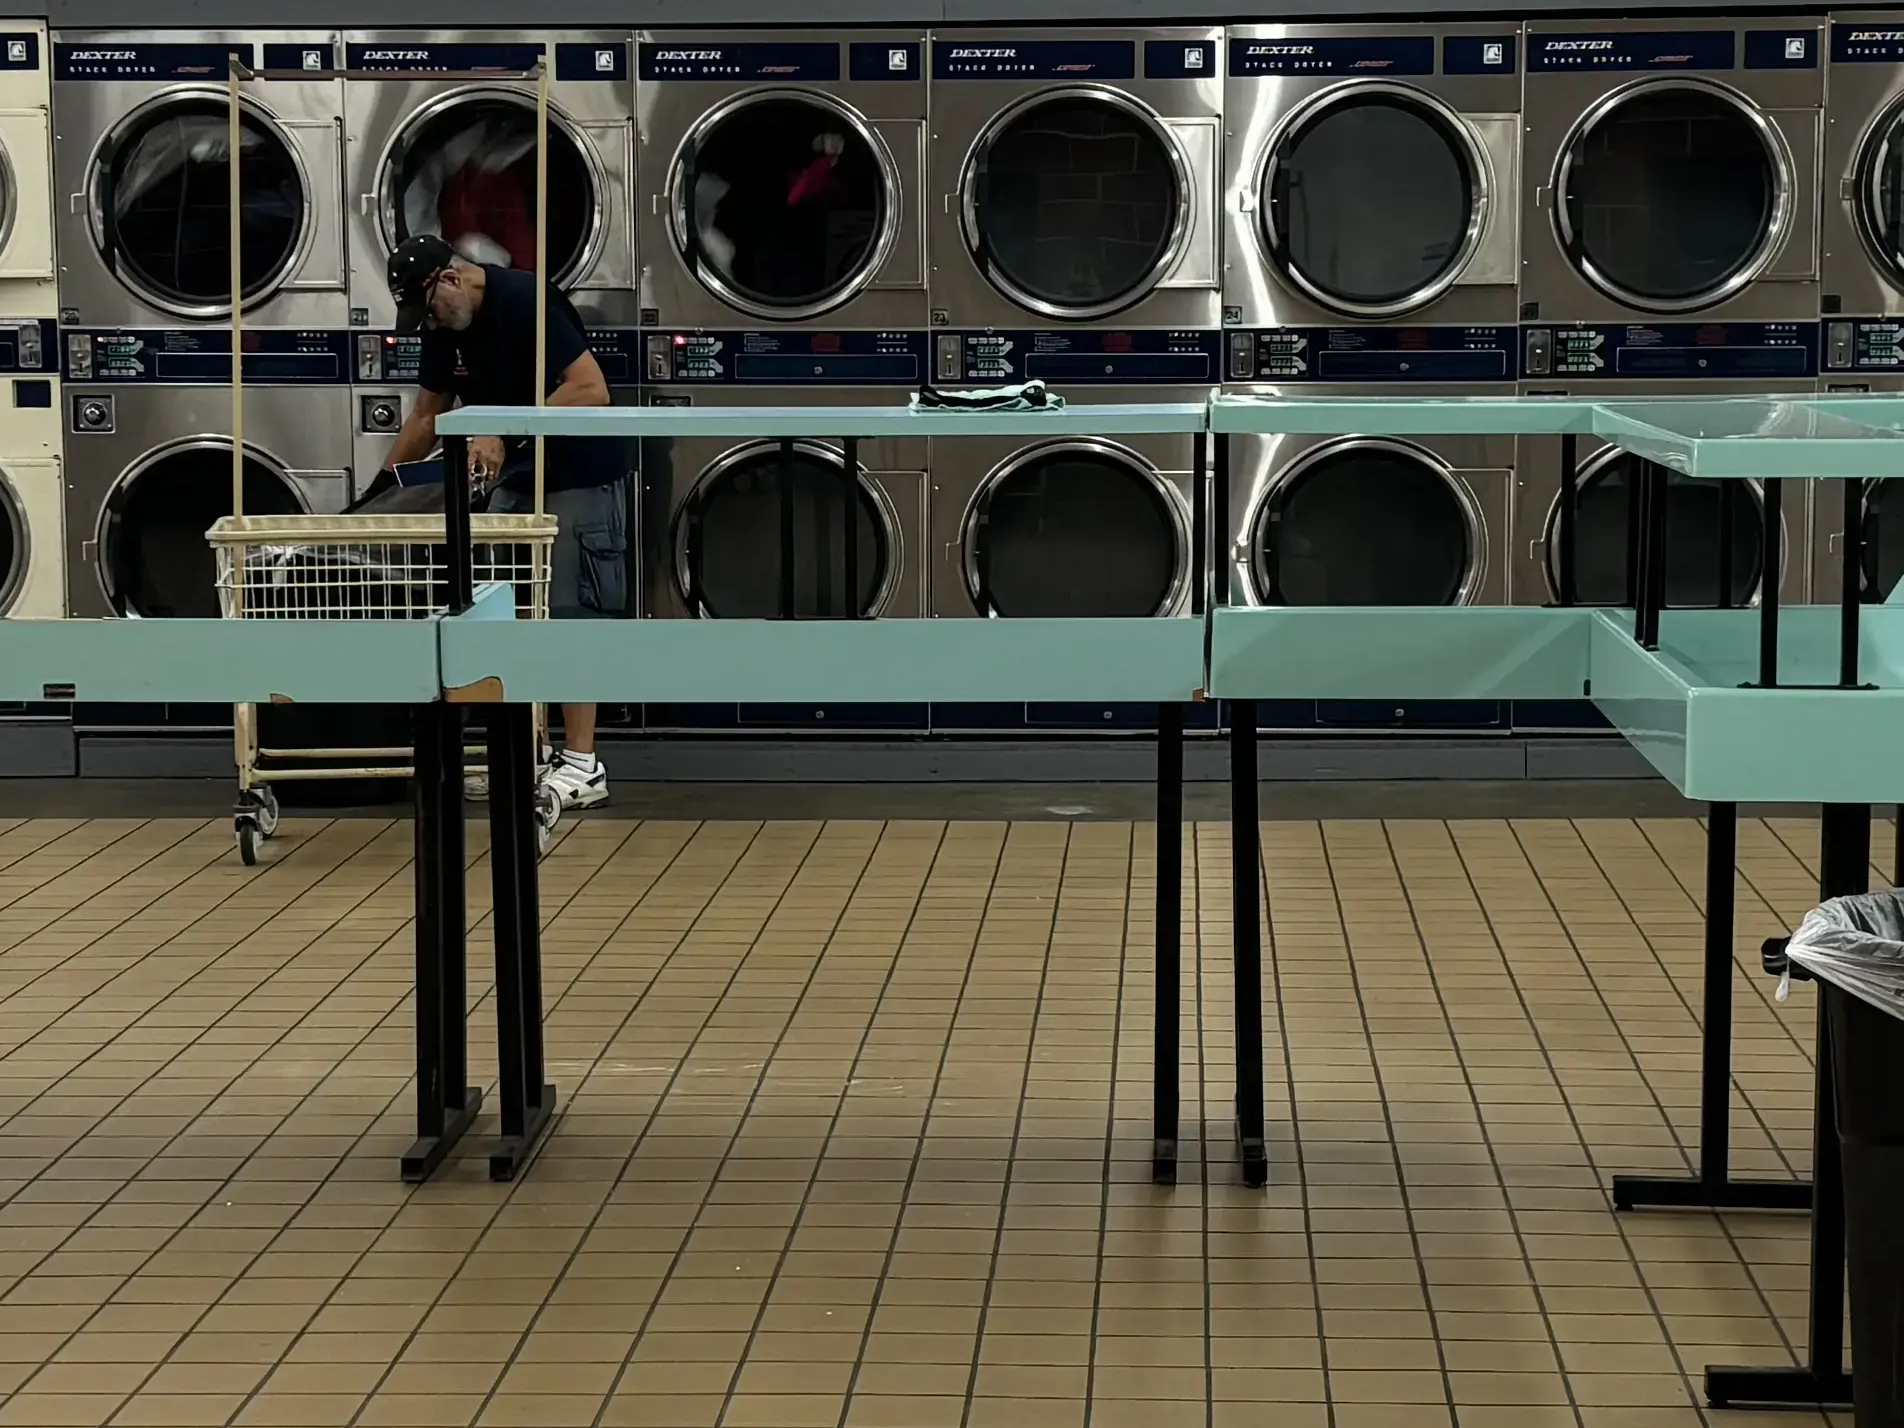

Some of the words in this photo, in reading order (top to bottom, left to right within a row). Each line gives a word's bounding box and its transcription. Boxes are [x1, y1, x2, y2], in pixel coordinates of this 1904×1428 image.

[1246, 45, 1314, 55] DEXTER
[1544, 40, 1613, 51] DEXTER
[70, 51, 137, 60] DEXTER
[363, 50, 429, 60] DEXTER
[655, 50, 722, 60] DEXTER
[949, 48, 1016, 58] DEXTER
